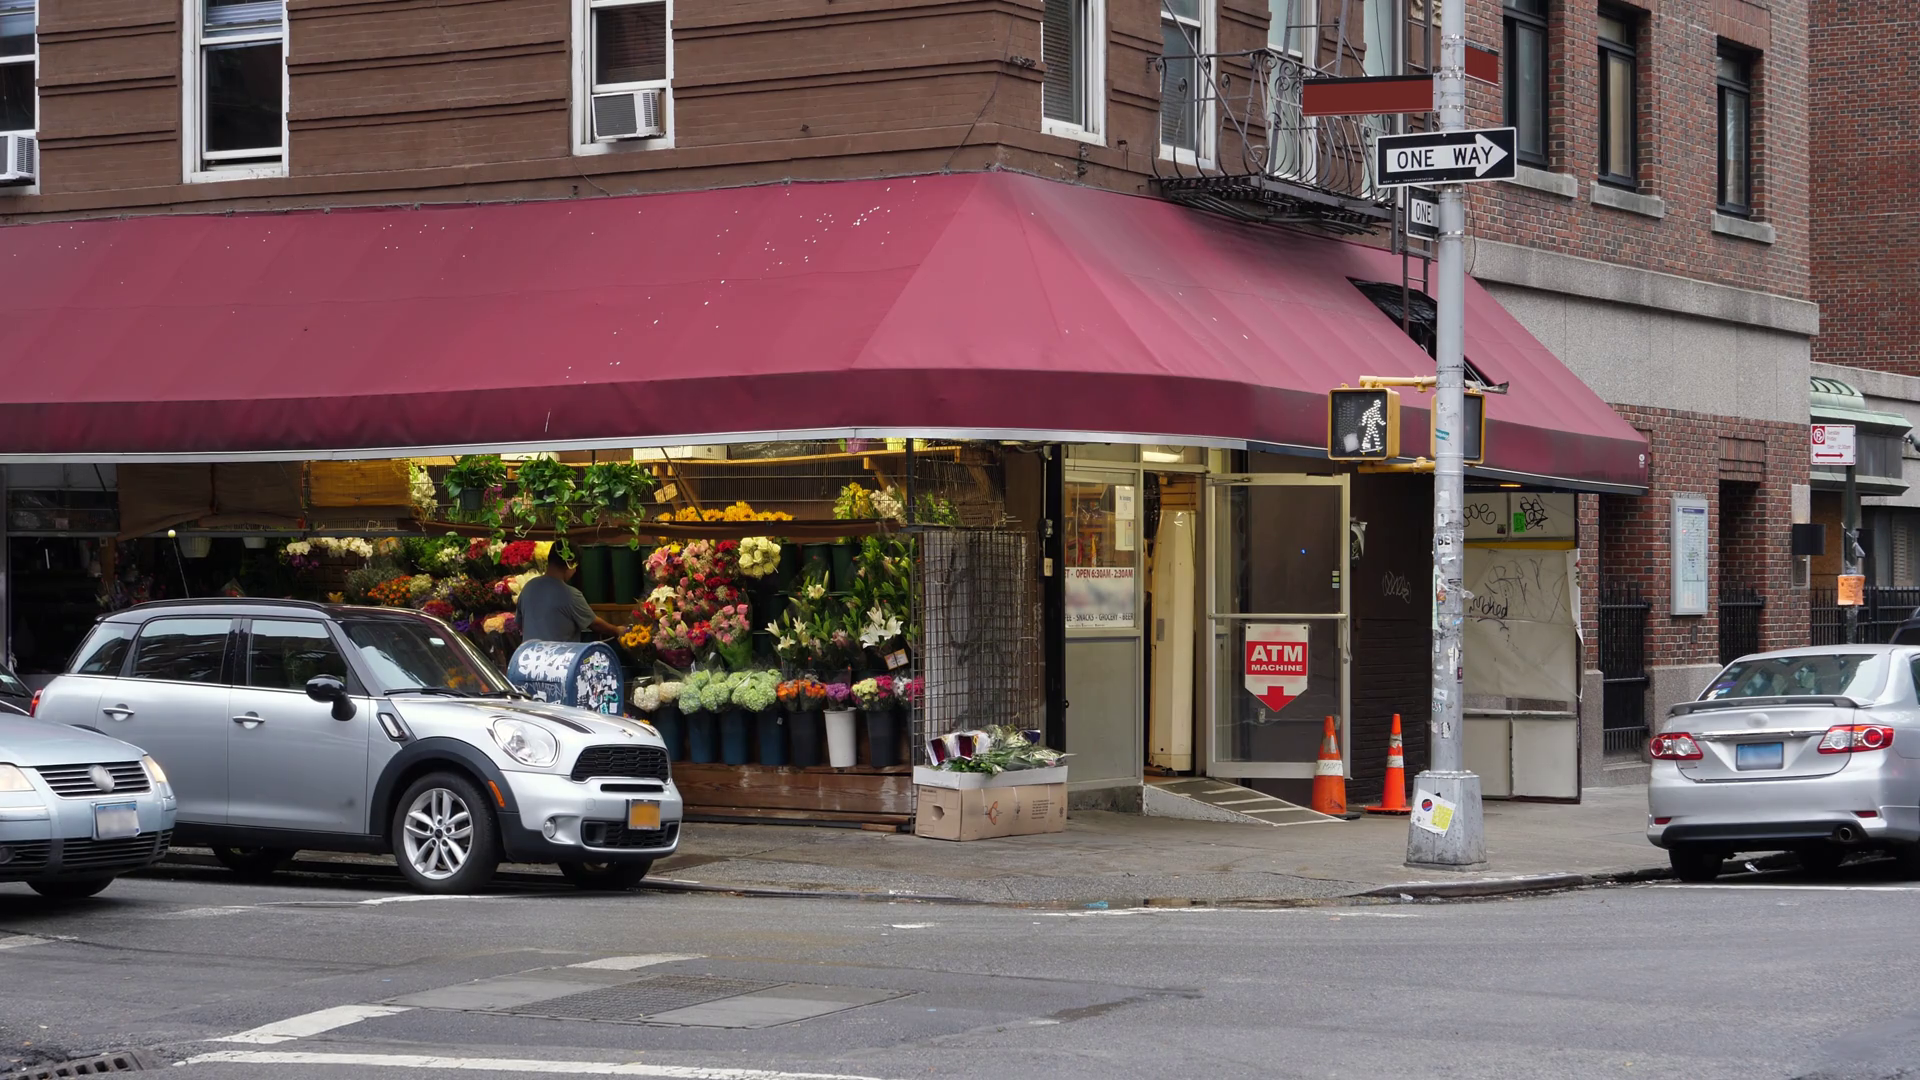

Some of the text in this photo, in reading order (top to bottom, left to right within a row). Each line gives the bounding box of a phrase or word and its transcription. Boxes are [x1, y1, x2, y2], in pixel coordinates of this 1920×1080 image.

[1397, 146, 1494, 169] ONE WAY
[1416, 202, 1431, 223] ONE
[1076, 569, 1090, 578] OPEN
[1250, 645, 1302, 662] ATM
